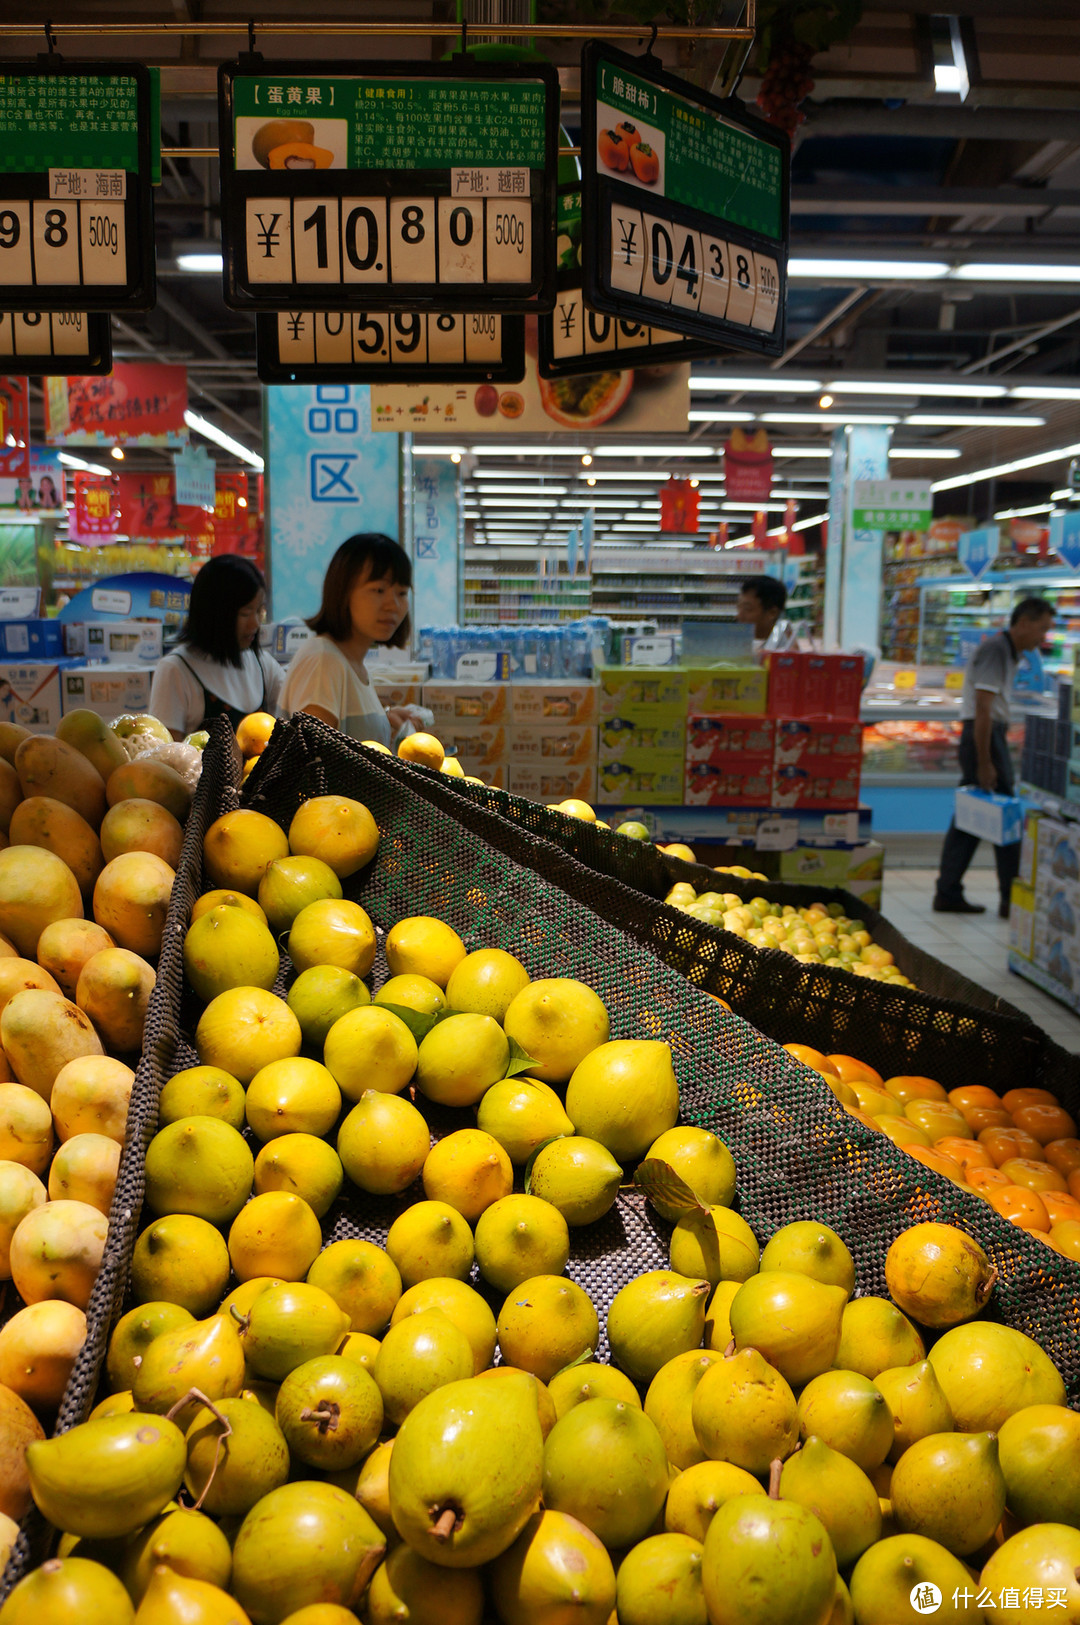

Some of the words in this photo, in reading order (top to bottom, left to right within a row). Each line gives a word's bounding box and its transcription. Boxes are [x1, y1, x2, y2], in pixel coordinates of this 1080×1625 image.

[254, 84, 335, 106] 【蛋黄果】
[276, 107, 291, 116] Egg
[54, 172, 123, 196] 产地：海南
[455, 170, 527, 193] 产地：越南
[89, 216, 118, 255] 500g
[495, 214, 525, 254] 500g
[760, 265, 776, 304] 500g
[472, 312, 496, 341] 500g
